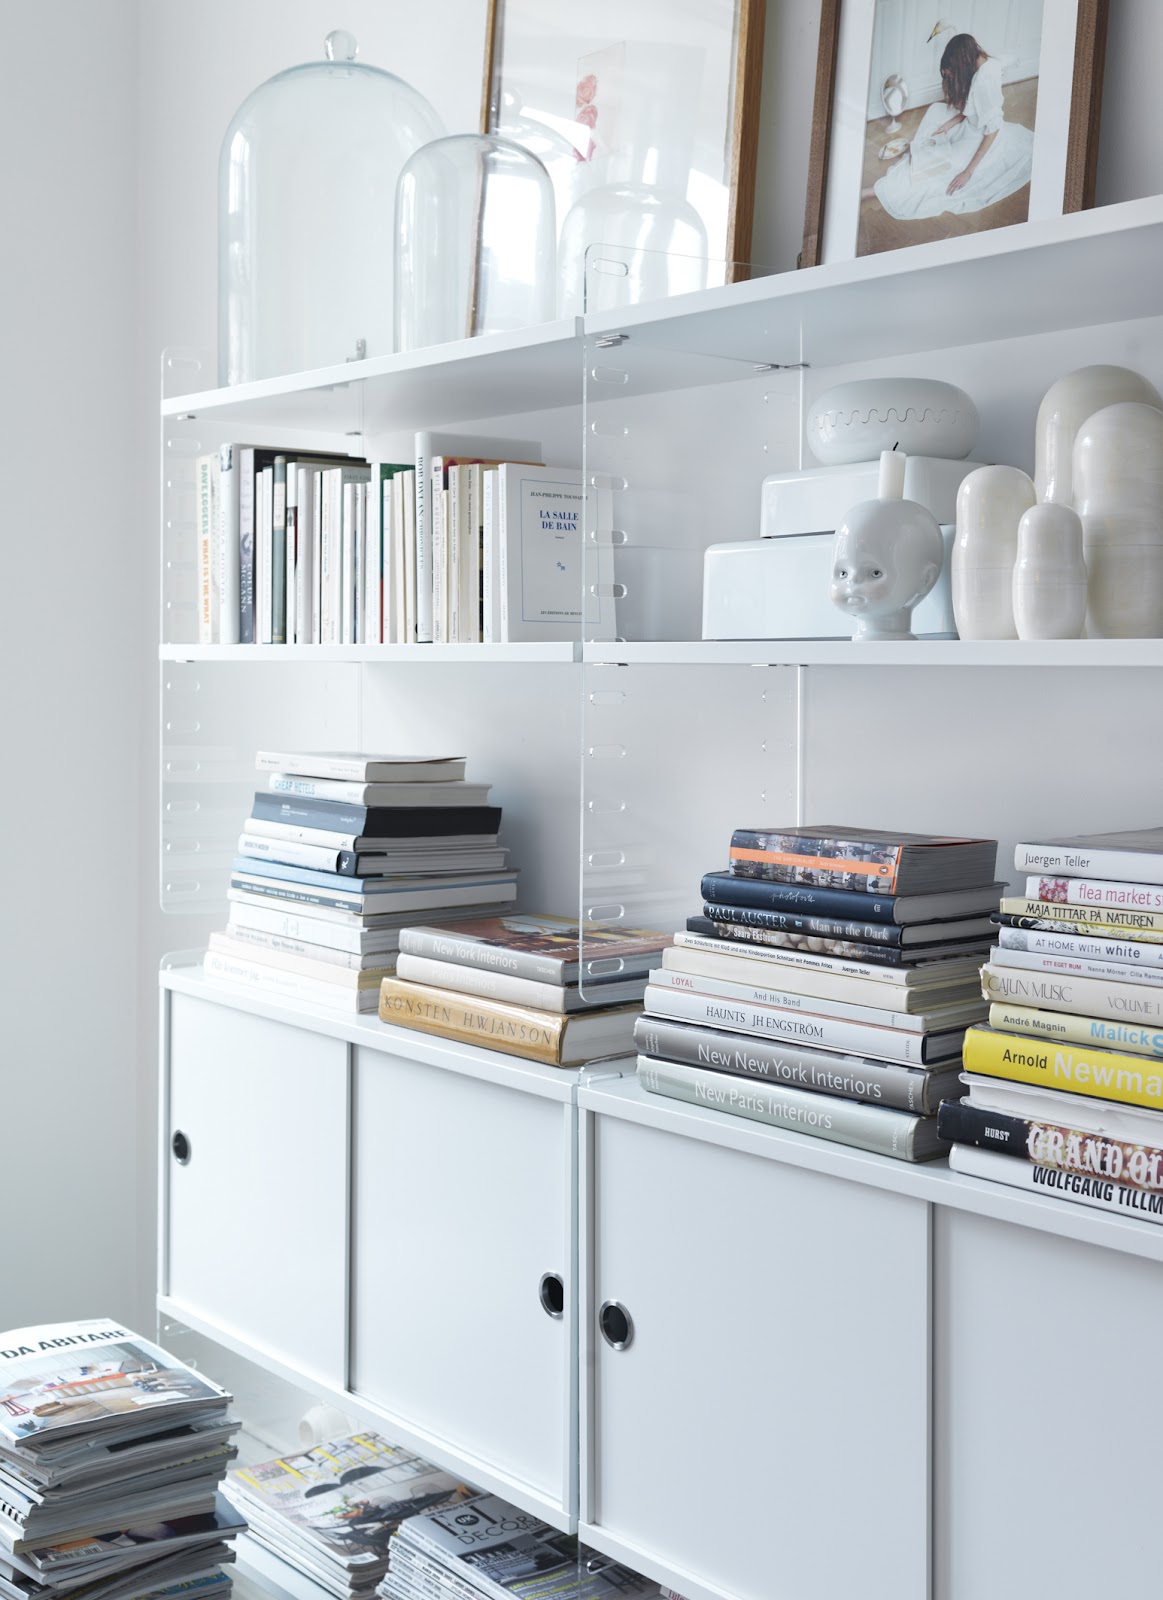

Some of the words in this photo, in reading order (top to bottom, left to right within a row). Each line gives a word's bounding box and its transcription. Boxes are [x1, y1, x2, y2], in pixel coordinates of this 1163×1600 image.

[530, 491, 562, 499] JEAN-PHILIPPE
[540, 510, 550, 519] LA
[552, 511, 579, 521] SALLE
[542, 521, 554, 530] DE
[556, 522, 577, 532] BAIN
[203, 568, 209, 578] IS
[274, 780, 292, 791] CHEAP
[294, 783, 316, 795] HOTELS
[1024, 852, 1060, 868] Juergen
[1064, 855, 1090, 868] Teller
[1078, 884, 1102, 900] flea
[1106, 888, 1152, 906] market
[708, 906, 736, 922] PAUL
[737, 908, 788, 928] AUSTER
[810, 919, 830, 934] Man
[833, 922, 843, 934] in
[845, 922, 861, 936] the
[864, 925, 890, 940] Dark
[1025, 902, 1051, 918] MAJA
[1052, 907, 1088, 922] TITTAR
[1090, 910, 1103, 922] PÅ
[1106, 912, 1154, 928] NATUREN
[733, 926, 750, 940] Saara
[752, 929, 778, 943] Ekström
[432, 940, 454, 956] New
[456, 944, 474, 961] York
[476, 948, 518, 970] Interiors
[1036, 938, 1046, 947] AT
[1048, 940, 1075, 952] HOME
[1078, 944, 1102, 955] WITH
[1105, 944, 1141, 958] white
[748, 949, 776, 959] Kinderportion
[776, 954, 795, 963] Schnitzel
[803, 959, 820, 967] Pommes
[821, 962, 832, 970] Frites
[1054, 960, 1068, 968] EGET
[1068, 962, 1082, 970] RUM
[456, 970, 496, 990] Interiors
[842, 966, 858, 974] Juergen
[859, 968, 870, 976] Teller
[1106, 968, 1126, 976] Mörner
[1130, 970, 1142, 978] Cilla
[672, 976, 694, 988] LOYAL
[754, 992, 767, 1001] And
[769, 994, 780, 1004] His
[782, 997, 800, 1007] Band
[988, 975, 1030, 997] CAJUN
[1032, 980, 1072, 1003] MUSIC
[1107, 996, 1152, 1016] VOLUME
[384, 995, 452, 1022] KONSTEN
[706, 1006, 746, 1022] HAUNTS
[752, 1014, 764, 1027] JH
[766, 1018, 824, 1038] ENGSTRÖM
[1002, 1014, 1030, 1027] André
[1032, 1019, 1066, 1033] Magnin
[1090, 1022, 1150, 1046] Malick
[698, 1044, 731, 1066] New
[735, 1051, 770, 1074] New
[772, 1058, 808, 1082] York
[812, 1066, 882, 1098] Interiors
[1002, 1048, 1048, 1070] Arnold
[1054, 1052, 1162, 1097] Newma
[695, 1080, 726, 1104] New
[729, 1088, 764, 1112] Paris
[768, 1097, 832, 1128] Interiors
[984, 1126, 1010, 1142] HURST
[1026, 1125, 1122, 1178] GRAND
[1032, 1166, 1114, 1202] WOLFGANG
[0, 1346, 36, 1359] DA
[38, 1330, 132, 1350] ABITARE
